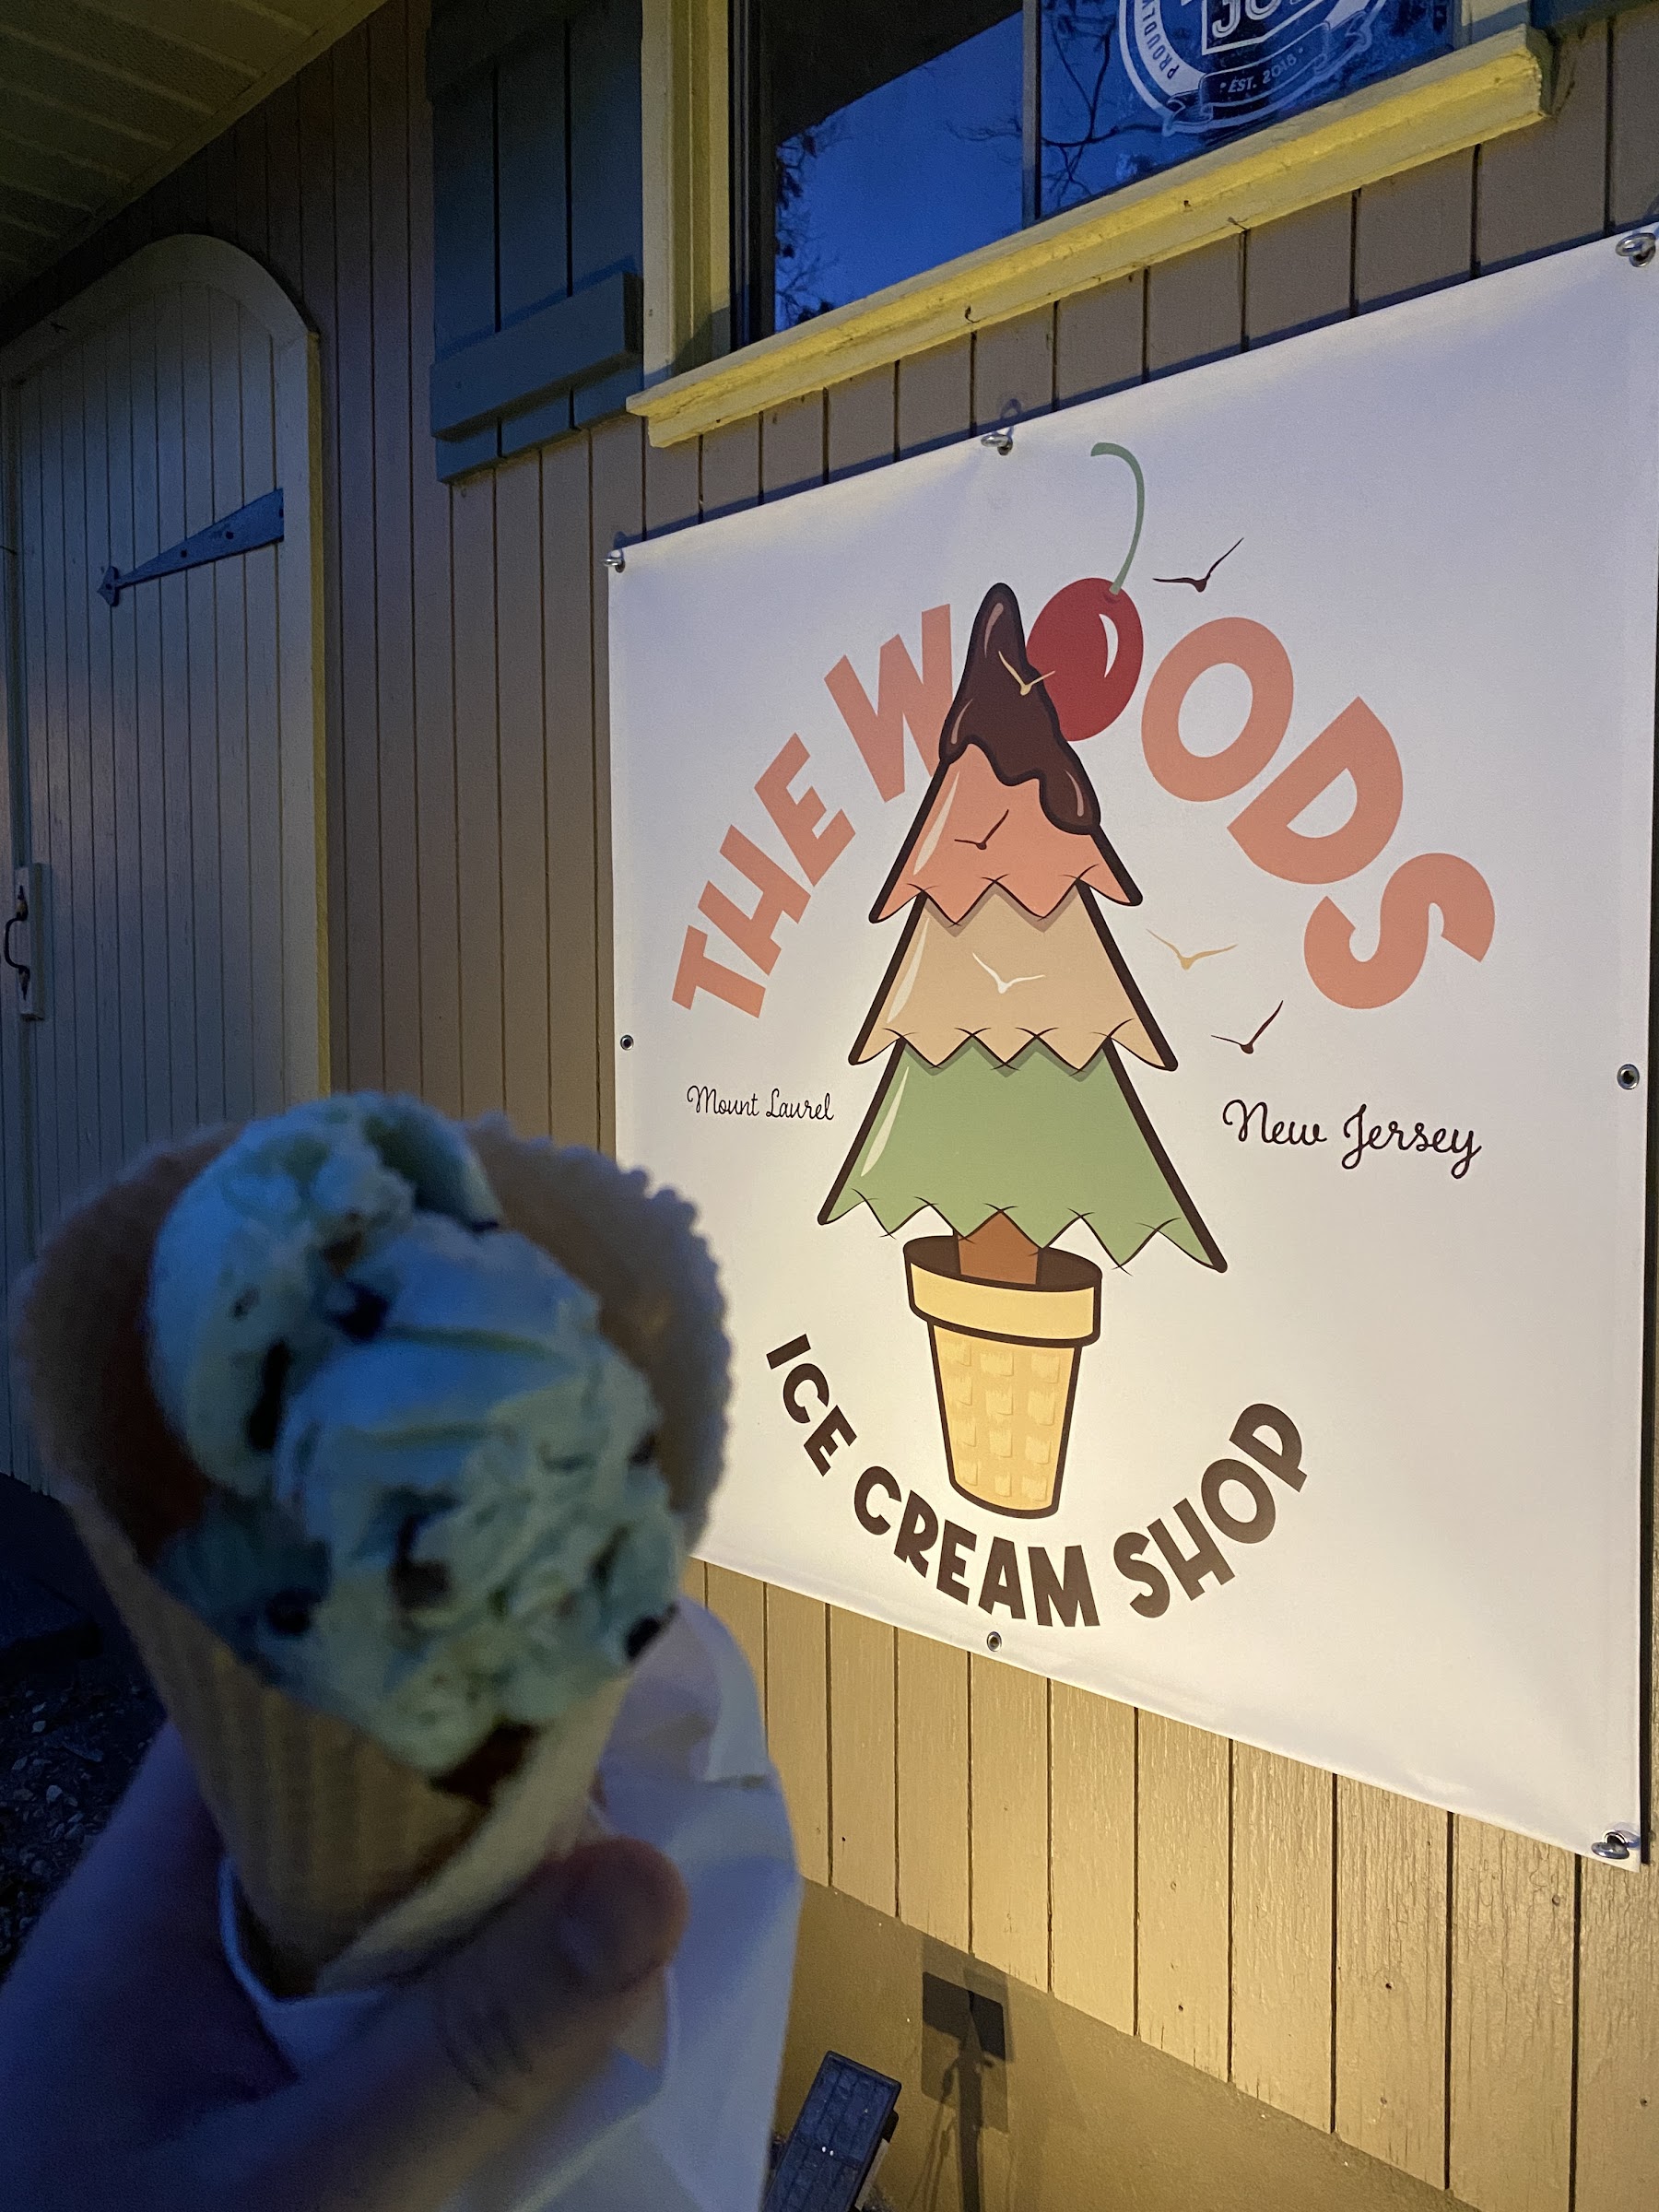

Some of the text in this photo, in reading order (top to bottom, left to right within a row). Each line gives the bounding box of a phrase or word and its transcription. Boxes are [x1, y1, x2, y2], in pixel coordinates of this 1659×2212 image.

[1228, 76, 1258, 93] EST.
[672, 733, 856, 1018] THE
[687, 1085, 834, 1121] Mount Laurel
[1222, 1099, 1482, 1180] New Jersey
[766, 1333, 1308, 1628] ICE CREAM SHOP
